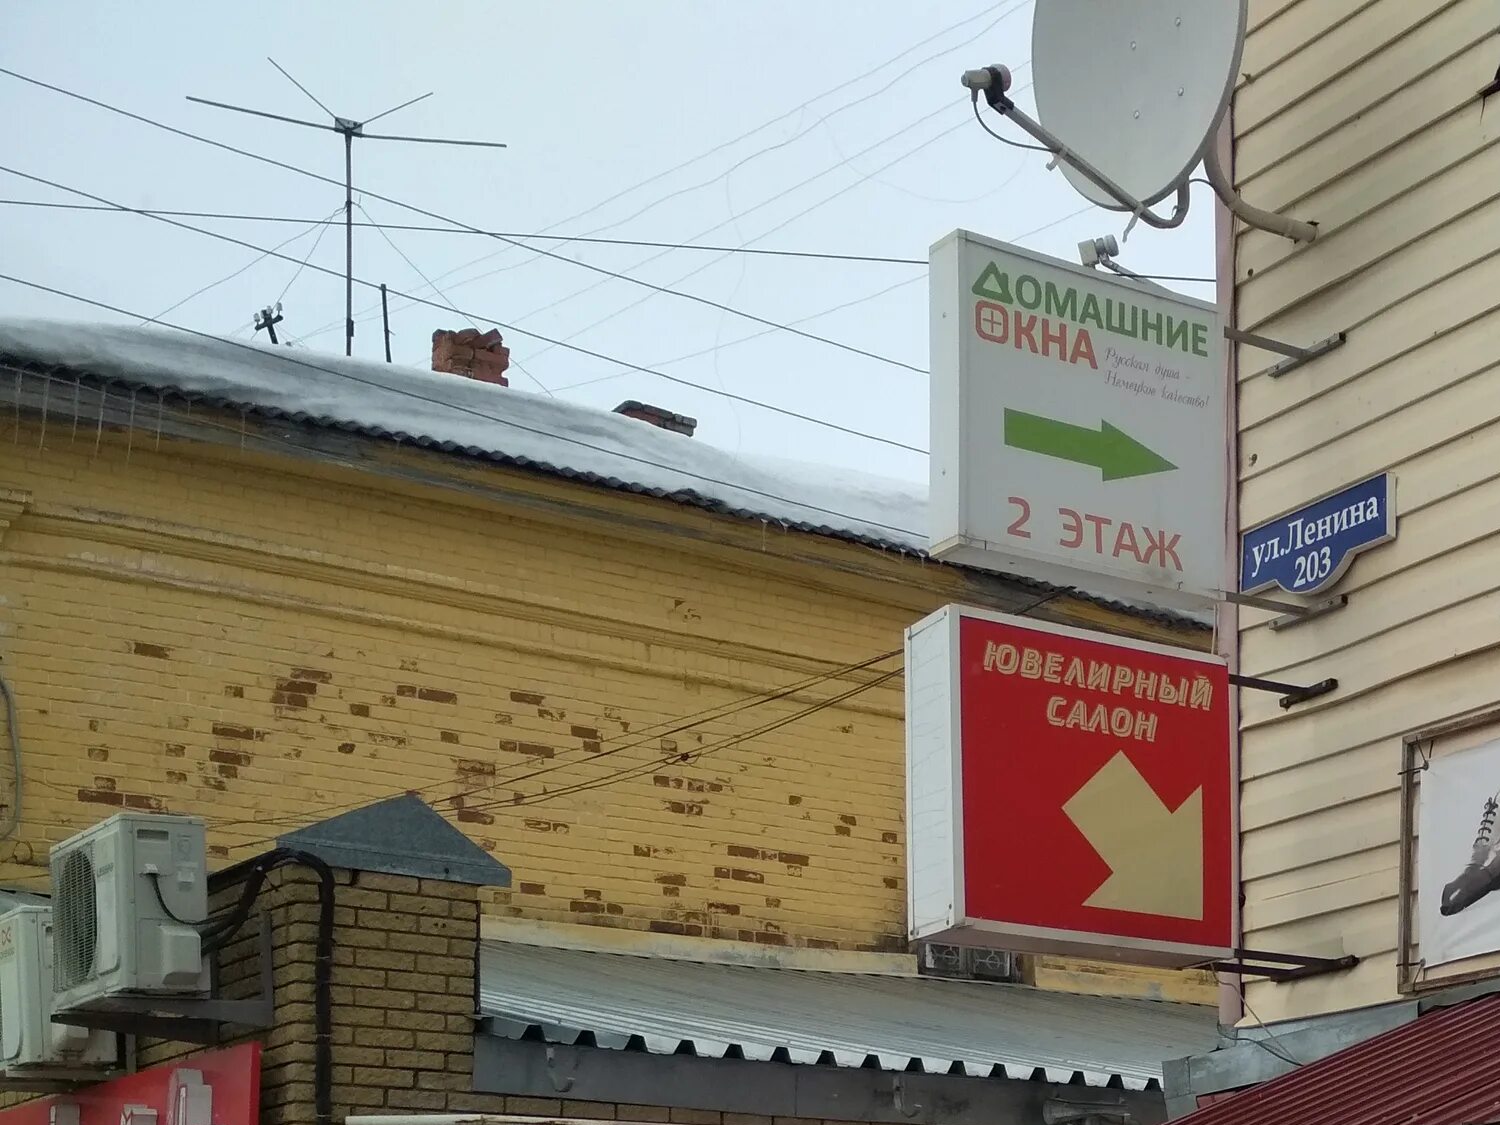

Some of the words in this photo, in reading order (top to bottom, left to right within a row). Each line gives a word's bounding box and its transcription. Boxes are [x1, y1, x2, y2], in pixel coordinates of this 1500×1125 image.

[971, 260, 1209, 358] ДОМАШНИЕ
[974, 300, 1099, 370] ОКНА
[1105, 347, 1150, 369] Русская
[1154, 362, 1181, 381] душа
[1006, 496, 1032, 539] 2
[1058, 507, 1184, 572] ЭТАЖ
[1251, 494, 1380, 578] ул.Ленина
[1293, 547, 1333, 589] 203
[983, 640, 1214, 711] ЮВЕЛИРНЫЙ
[1046, 695, 1159, 743] САЛОН
